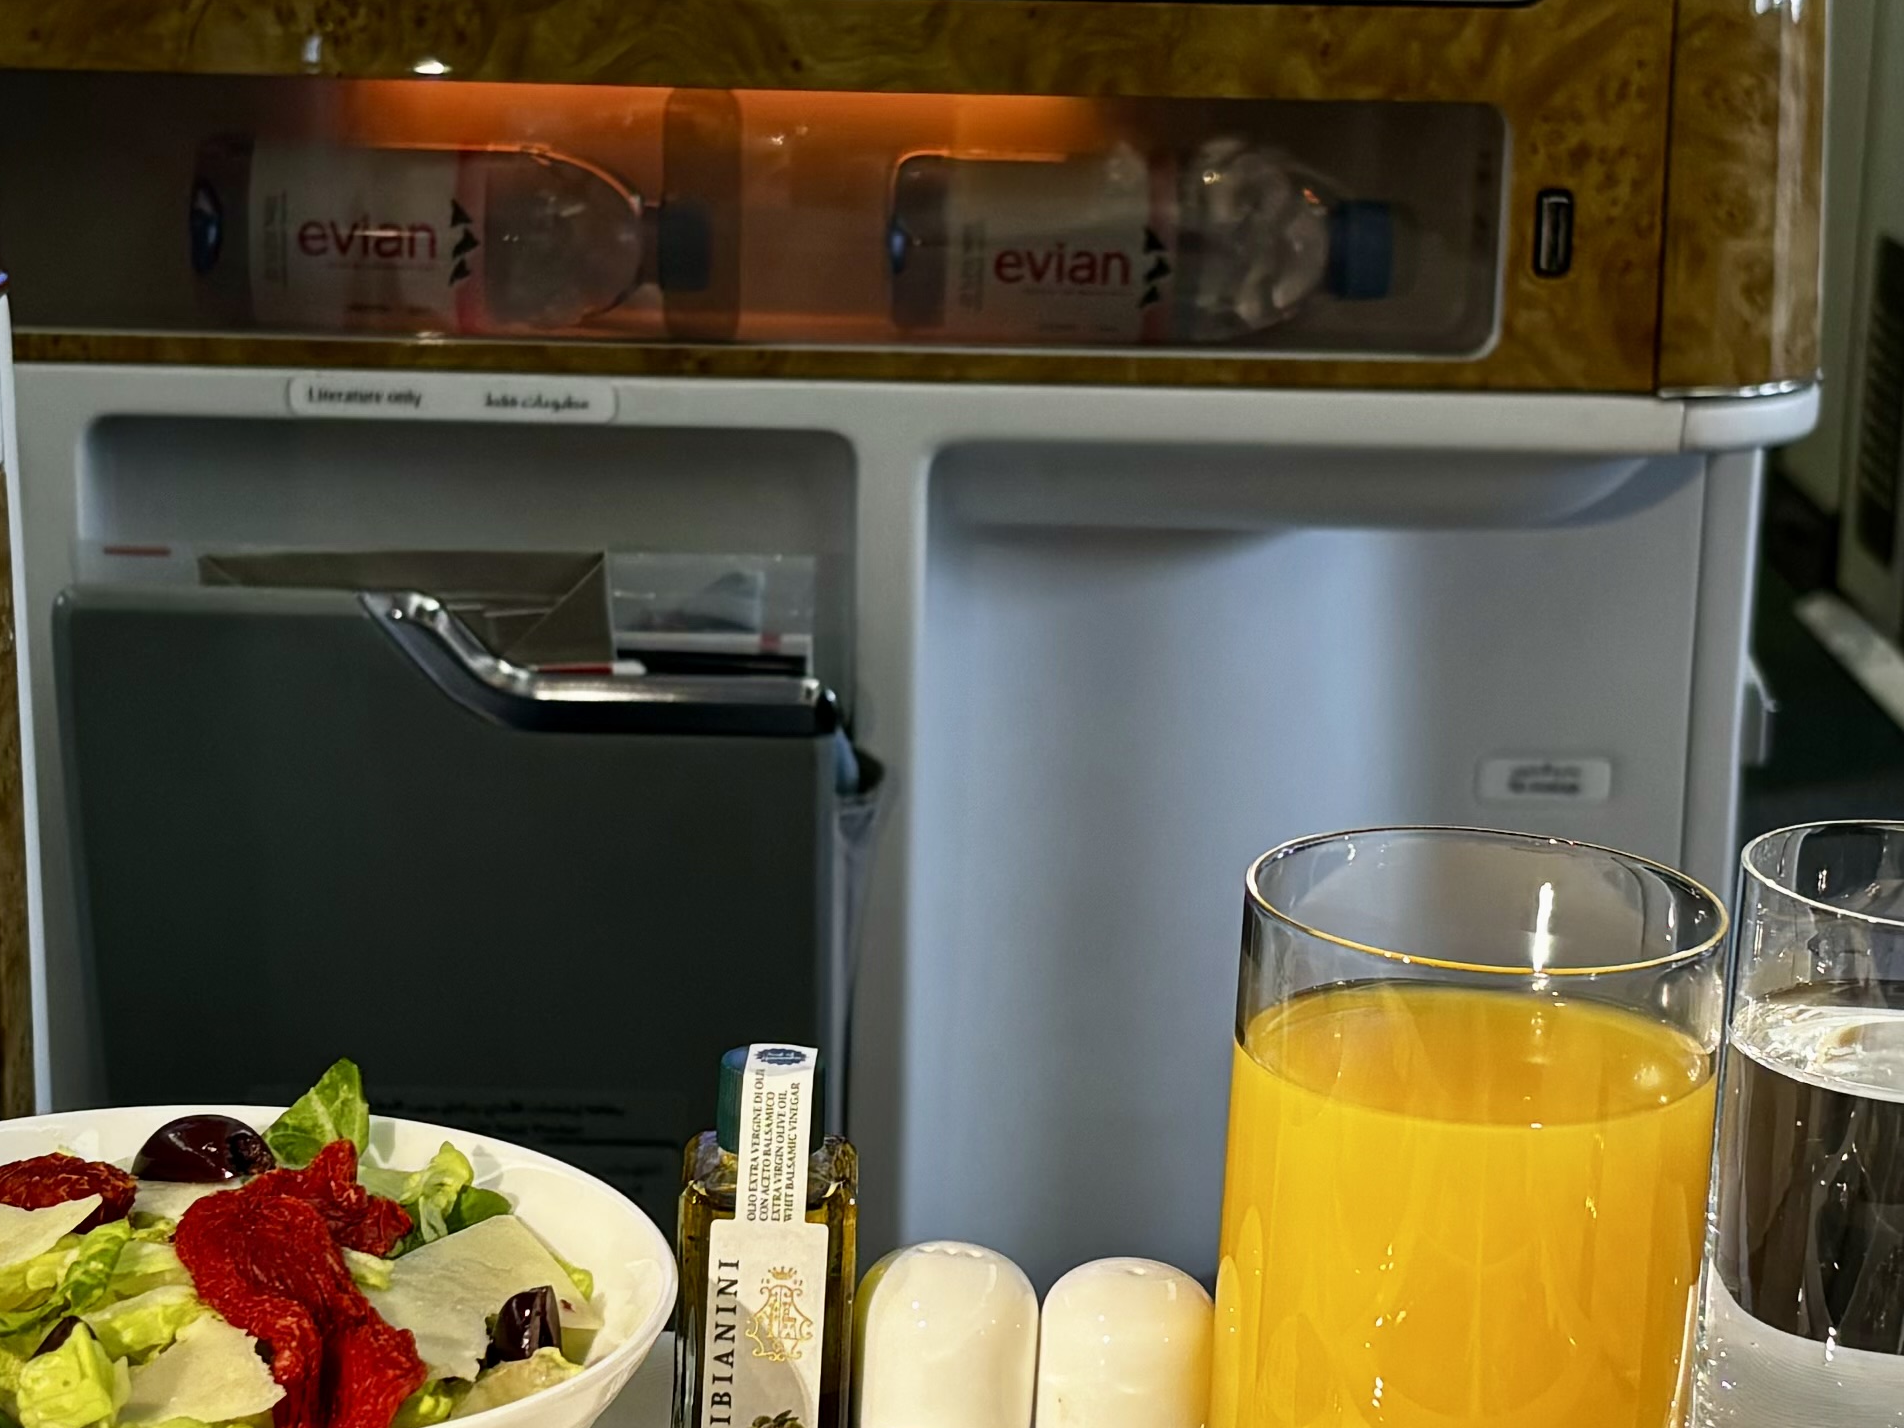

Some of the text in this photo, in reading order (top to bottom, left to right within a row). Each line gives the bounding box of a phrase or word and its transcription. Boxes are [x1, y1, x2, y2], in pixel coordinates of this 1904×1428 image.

[299, 215, 437, 260] evian
[994, 242, 1131, 286] evian
[309, 386, 421, 409] Literature only
[753, 1091, 763, 1104] DI
[789, 1082, 800, 1133] VINEGAR
[751, 1105, 762, 1155] VERGINE
[749, 1155, 759, 1192] EXTRA
[759, 1091, 776, 1221] CON ACETO BALSAMICO
[771, 1090, 787, 1222] EXTRA VIRGIN OLIVE OIL
[785, 1133, 797, 1191] BALSAMIC
[747, 1194, 756, 1221] OLIO
